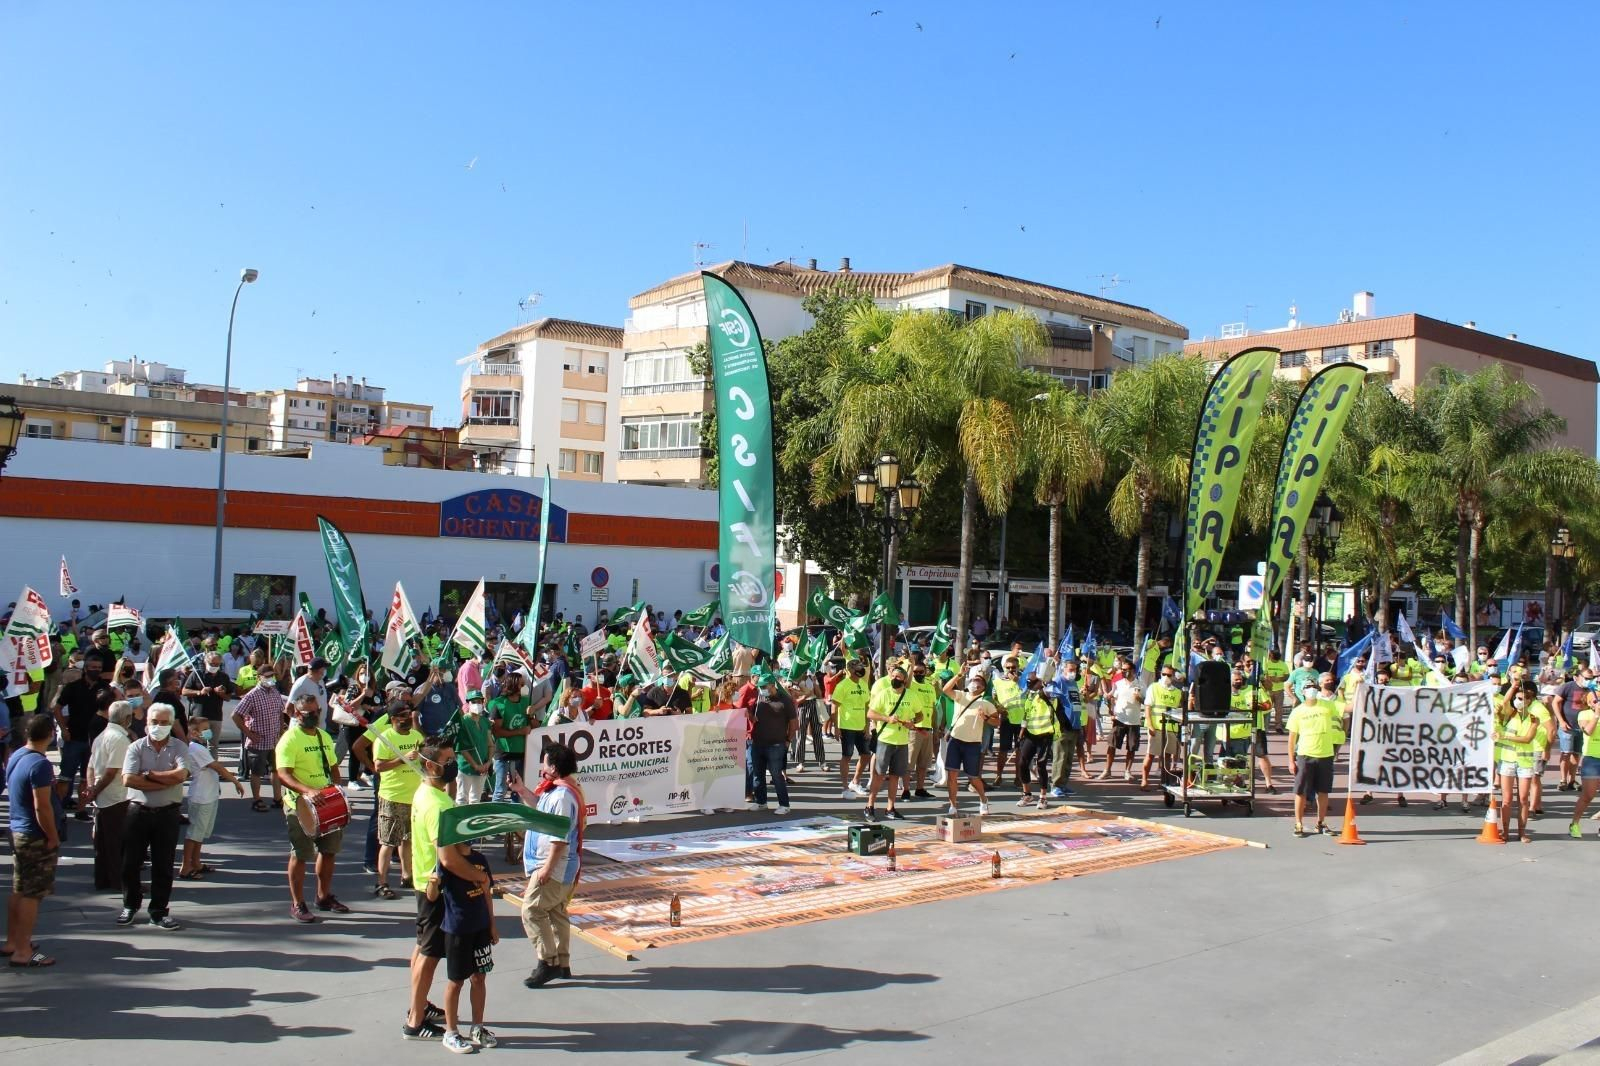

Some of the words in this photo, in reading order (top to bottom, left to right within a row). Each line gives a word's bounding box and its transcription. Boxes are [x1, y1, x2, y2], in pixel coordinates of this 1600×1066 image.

[463, 494, 543, 519] CASH
[1415, 687, 1491, 715] FALTA
[599, 729, 611, 742] A
[616, 726, 644, 742] LOS
[599, 739, 673, 759] RECORTES
[1382, 746, 1466, 766] SOBRAN
[620, 756, 670, 769] MUNICIPAL
[1356, 749, 1489, 791] LADRONES
[618, 767, 670, 780] TORREMOLINOS
